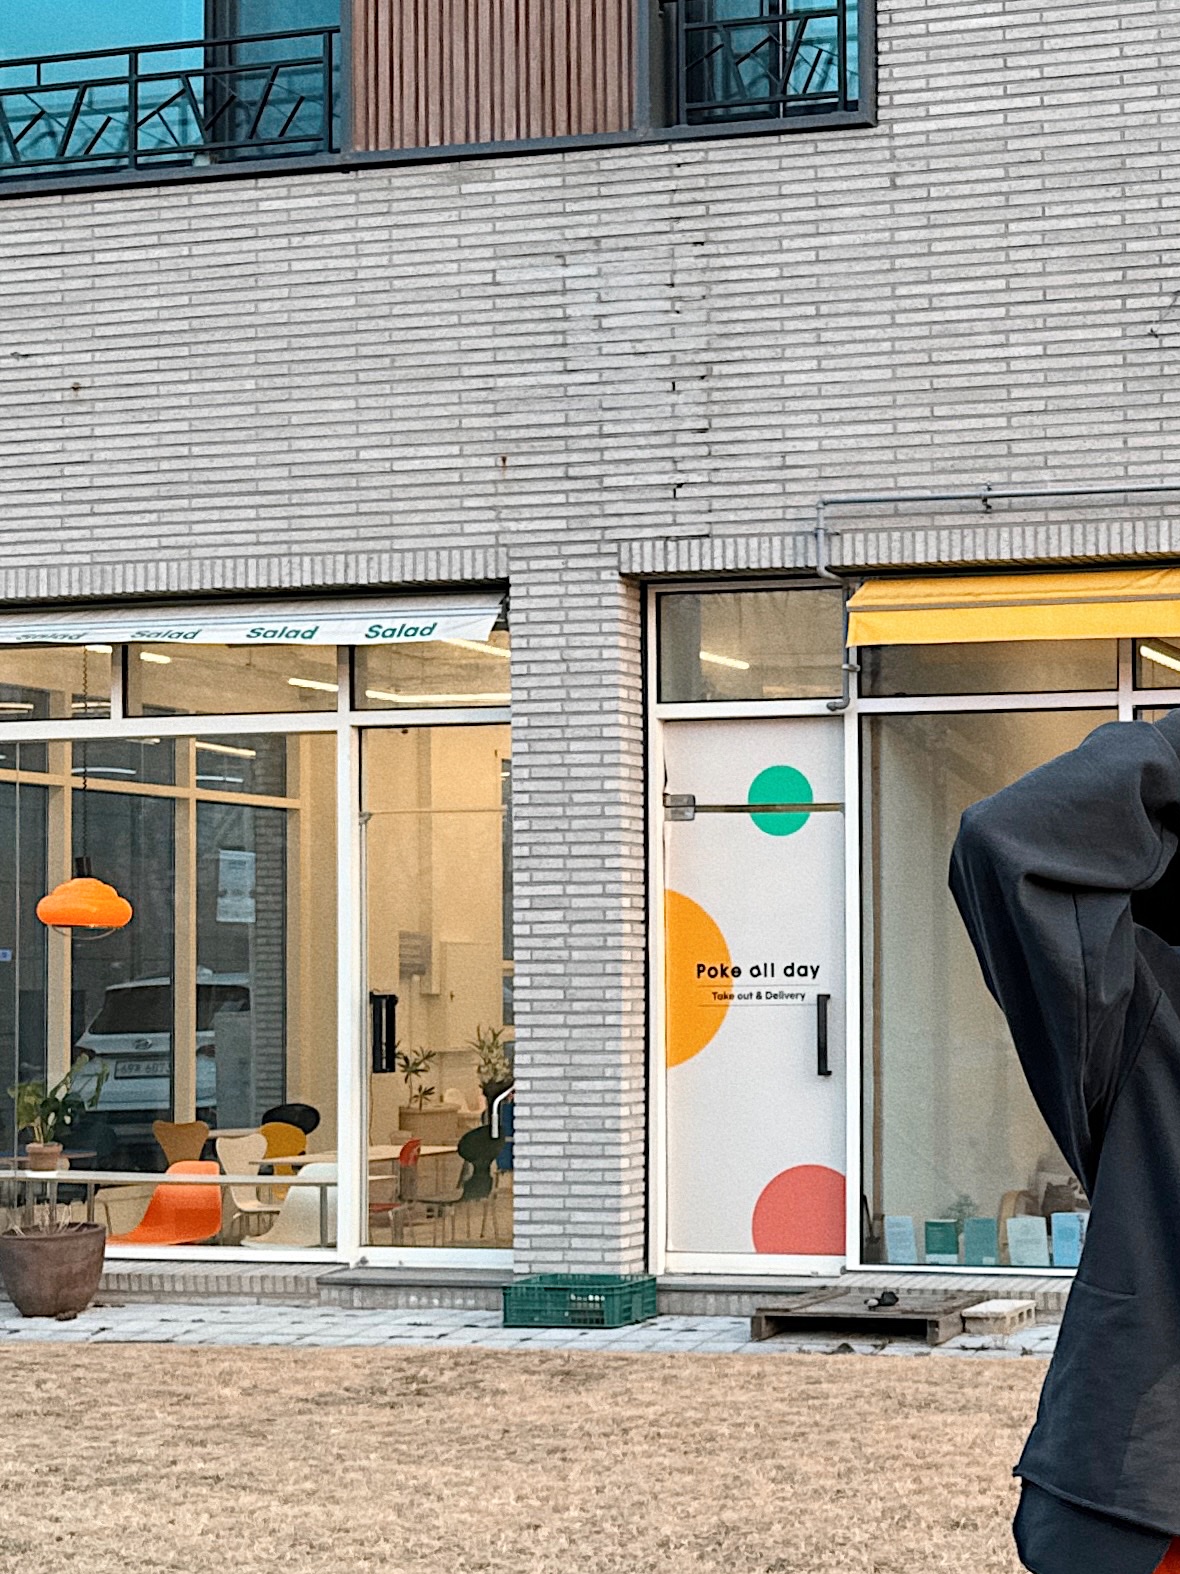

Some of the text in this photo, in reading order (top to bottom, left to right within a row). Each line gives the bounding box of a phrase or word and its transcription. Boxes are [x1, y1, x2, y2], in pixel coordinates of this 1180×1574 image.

[130, 629, 202, 640] Salad
[246, 626, 320, 640] Salad
[364, 622, 438, 639] Salad
[696, 962, 820, 980] Poke all day
[711, 990, 806, 1002] Take out & Delivery
